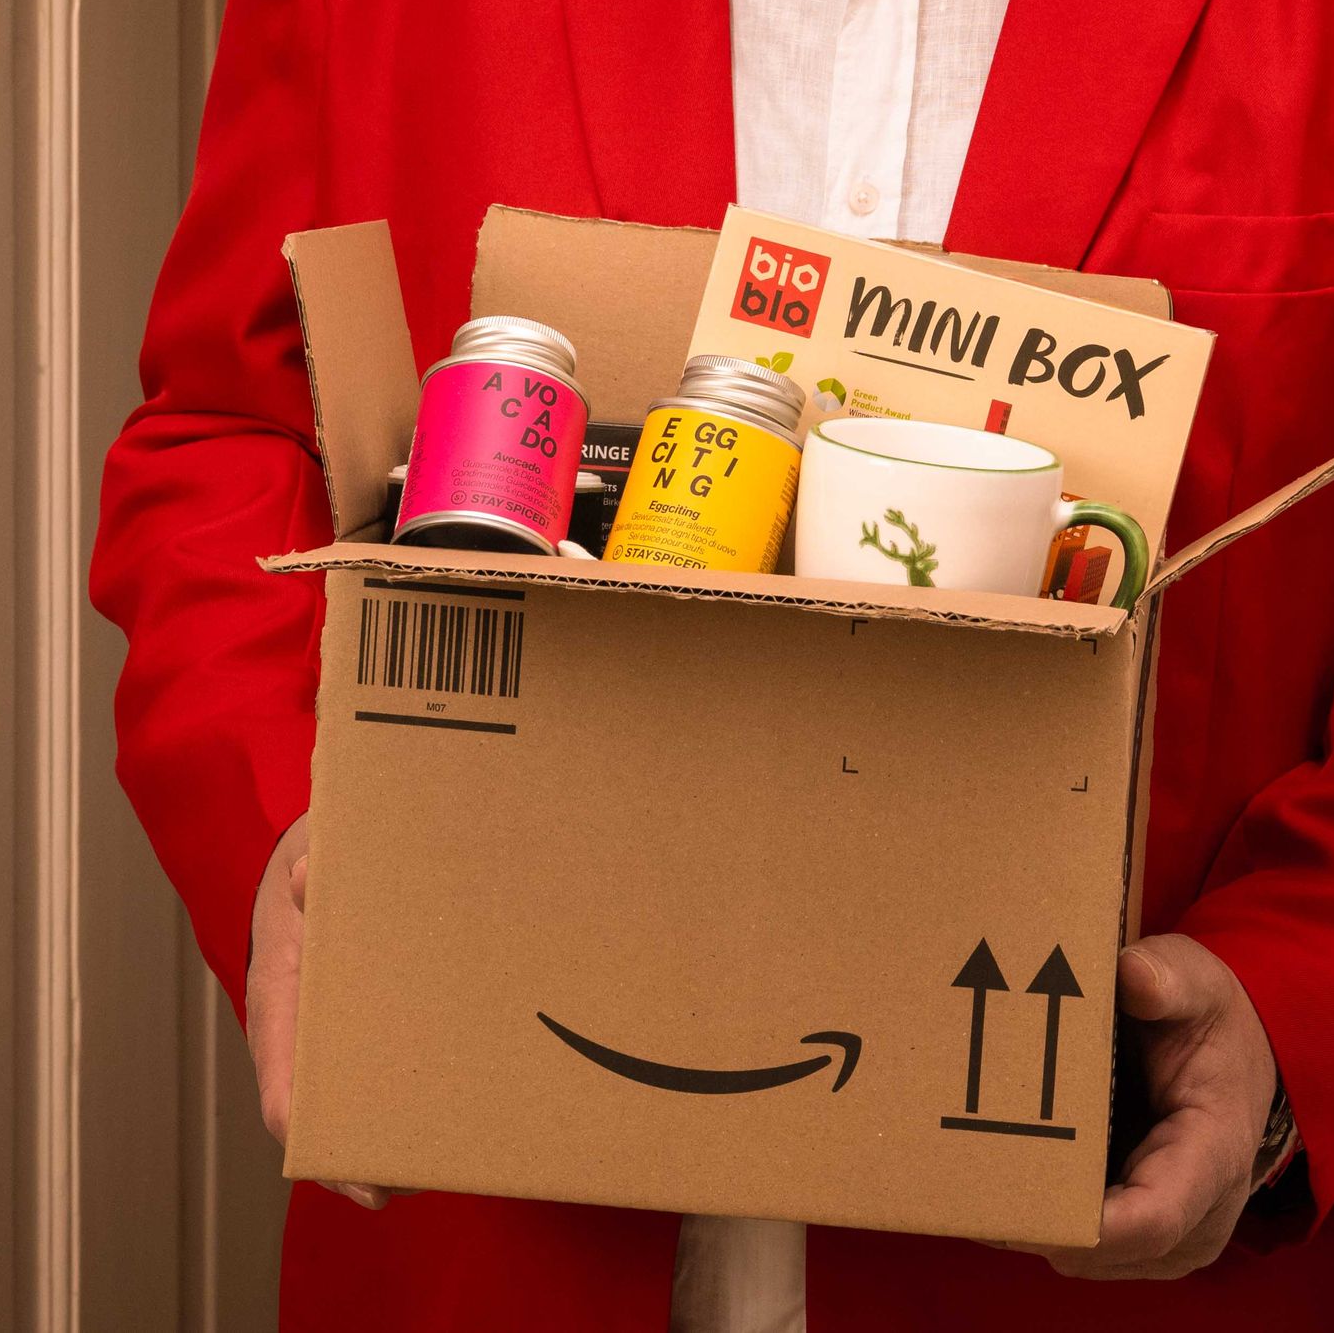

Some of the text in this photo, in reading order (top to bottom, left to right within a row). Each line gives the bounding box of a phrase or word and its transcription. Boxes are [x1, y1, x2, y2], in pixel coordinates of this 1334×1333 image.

[749, 245, 820, 292] bio
[740, 282, 810, 328] blo
[844, 276, 1170, 420] MINI BOX
[854, 389, 878, 402] Green
[851, 399, 911, 420] Product Award
[493, 452, 541, 474] Avocado
[471, 494, 504, 507] STAY
[505, 501, 551, 529] SPICED!
[649, 500, 701, 520] Eggciting
[656, 526, 670, 534] per
[691, 533, 708, 545] tipo
[661, 536, 681, 547] pour
[625, 547, 654, 560] STAY
[426, 702, 447, 713] M07
